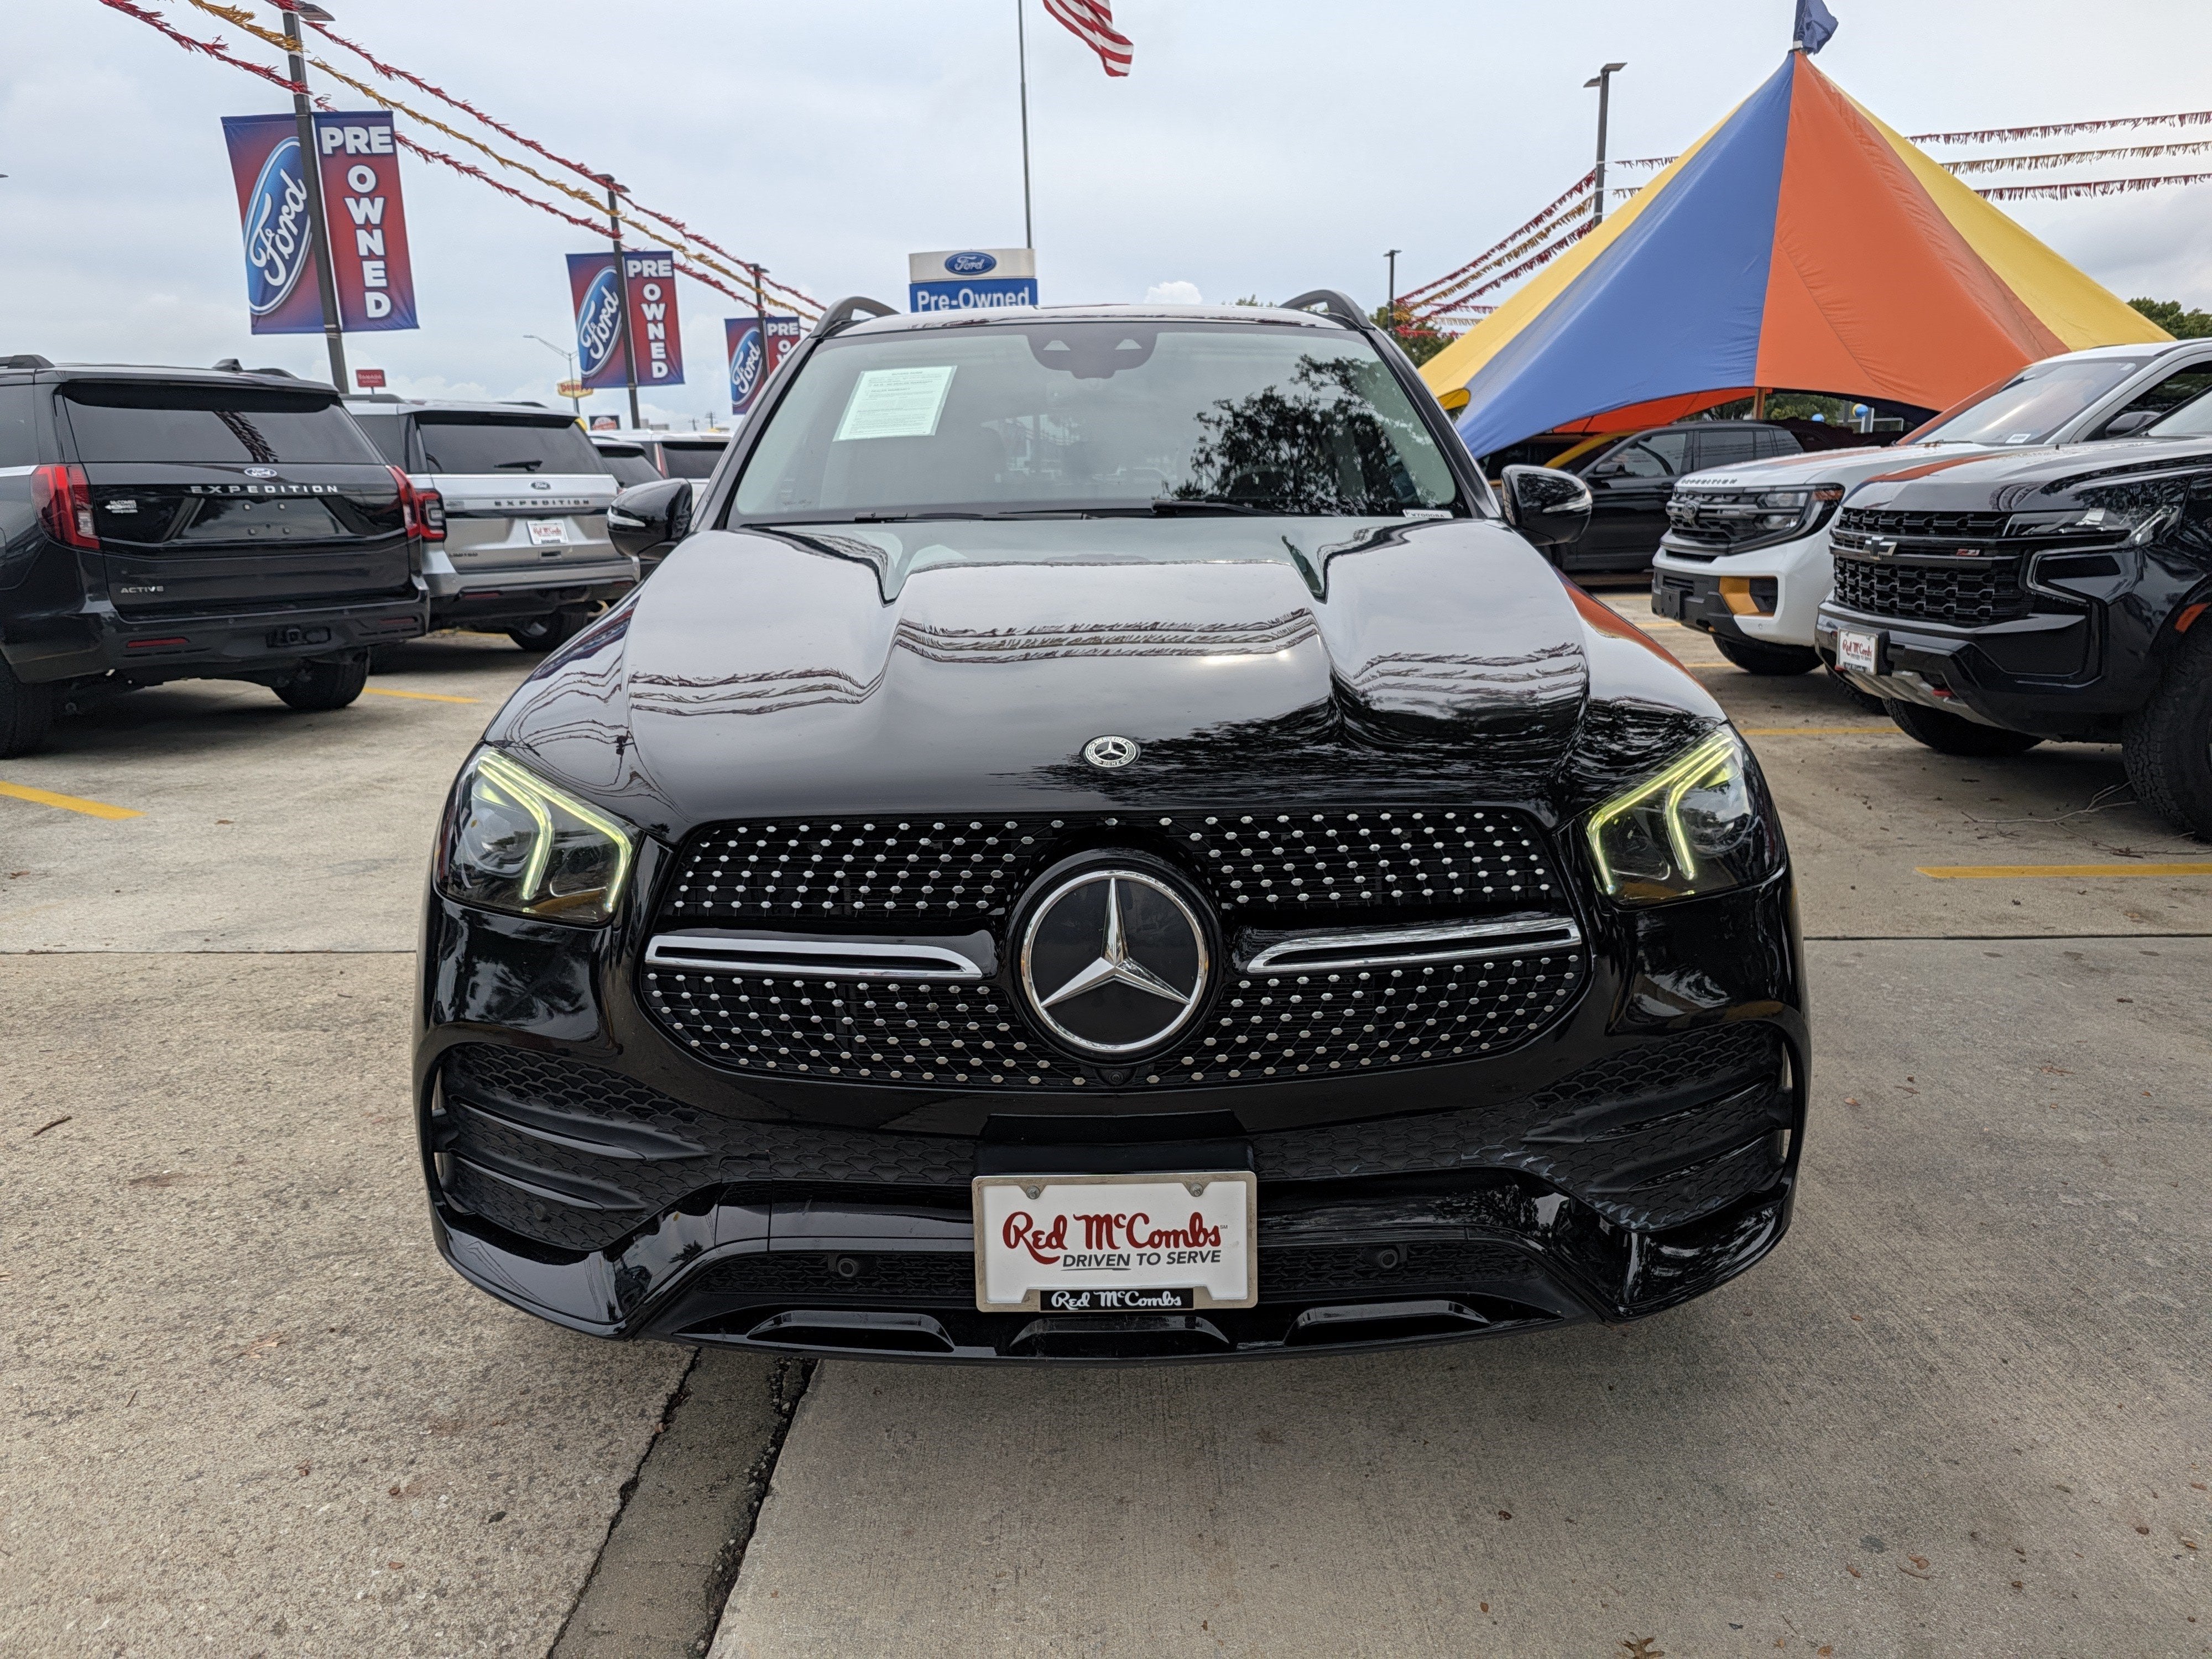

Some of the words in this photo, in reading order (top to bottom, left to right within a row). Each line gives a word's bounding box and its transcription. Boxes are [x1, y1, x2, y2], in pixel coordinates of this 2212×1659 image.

[320, 126, 394, 154] PRE
[249, 168, 307, 286] Ford
[344, 165, 392, 319] OWNED
[627, 259, 673, 278] PRE
[954, 256, 985, 271] Ford
[917, 287, 1030, 312] Pre-Owned
[581, 285, 619, 360] Ford
[641, 283, 668, 378] OWNED
[767, 322, 800, 336] PRE
[732, 341, 761, 394] Ford
[190, 485, 338, 494] EXPEDITION
[121, 586, 164, 594] ACTIVE
[1842, 639, 1852, 656] Red
[1002, 1211, 1068, 1265] Red
[1072, 1211, 1222, 1251] McCombs
[1062, 1254, 1130, 1267] DRIVEN
[1137, 1252, 1161, 1266] TO
[1166, 1250, 1222, 1265] SERVE
[1051, 1291, 1090, 1310] Red
[1093, 1290, 1182, 1307] McCombs
